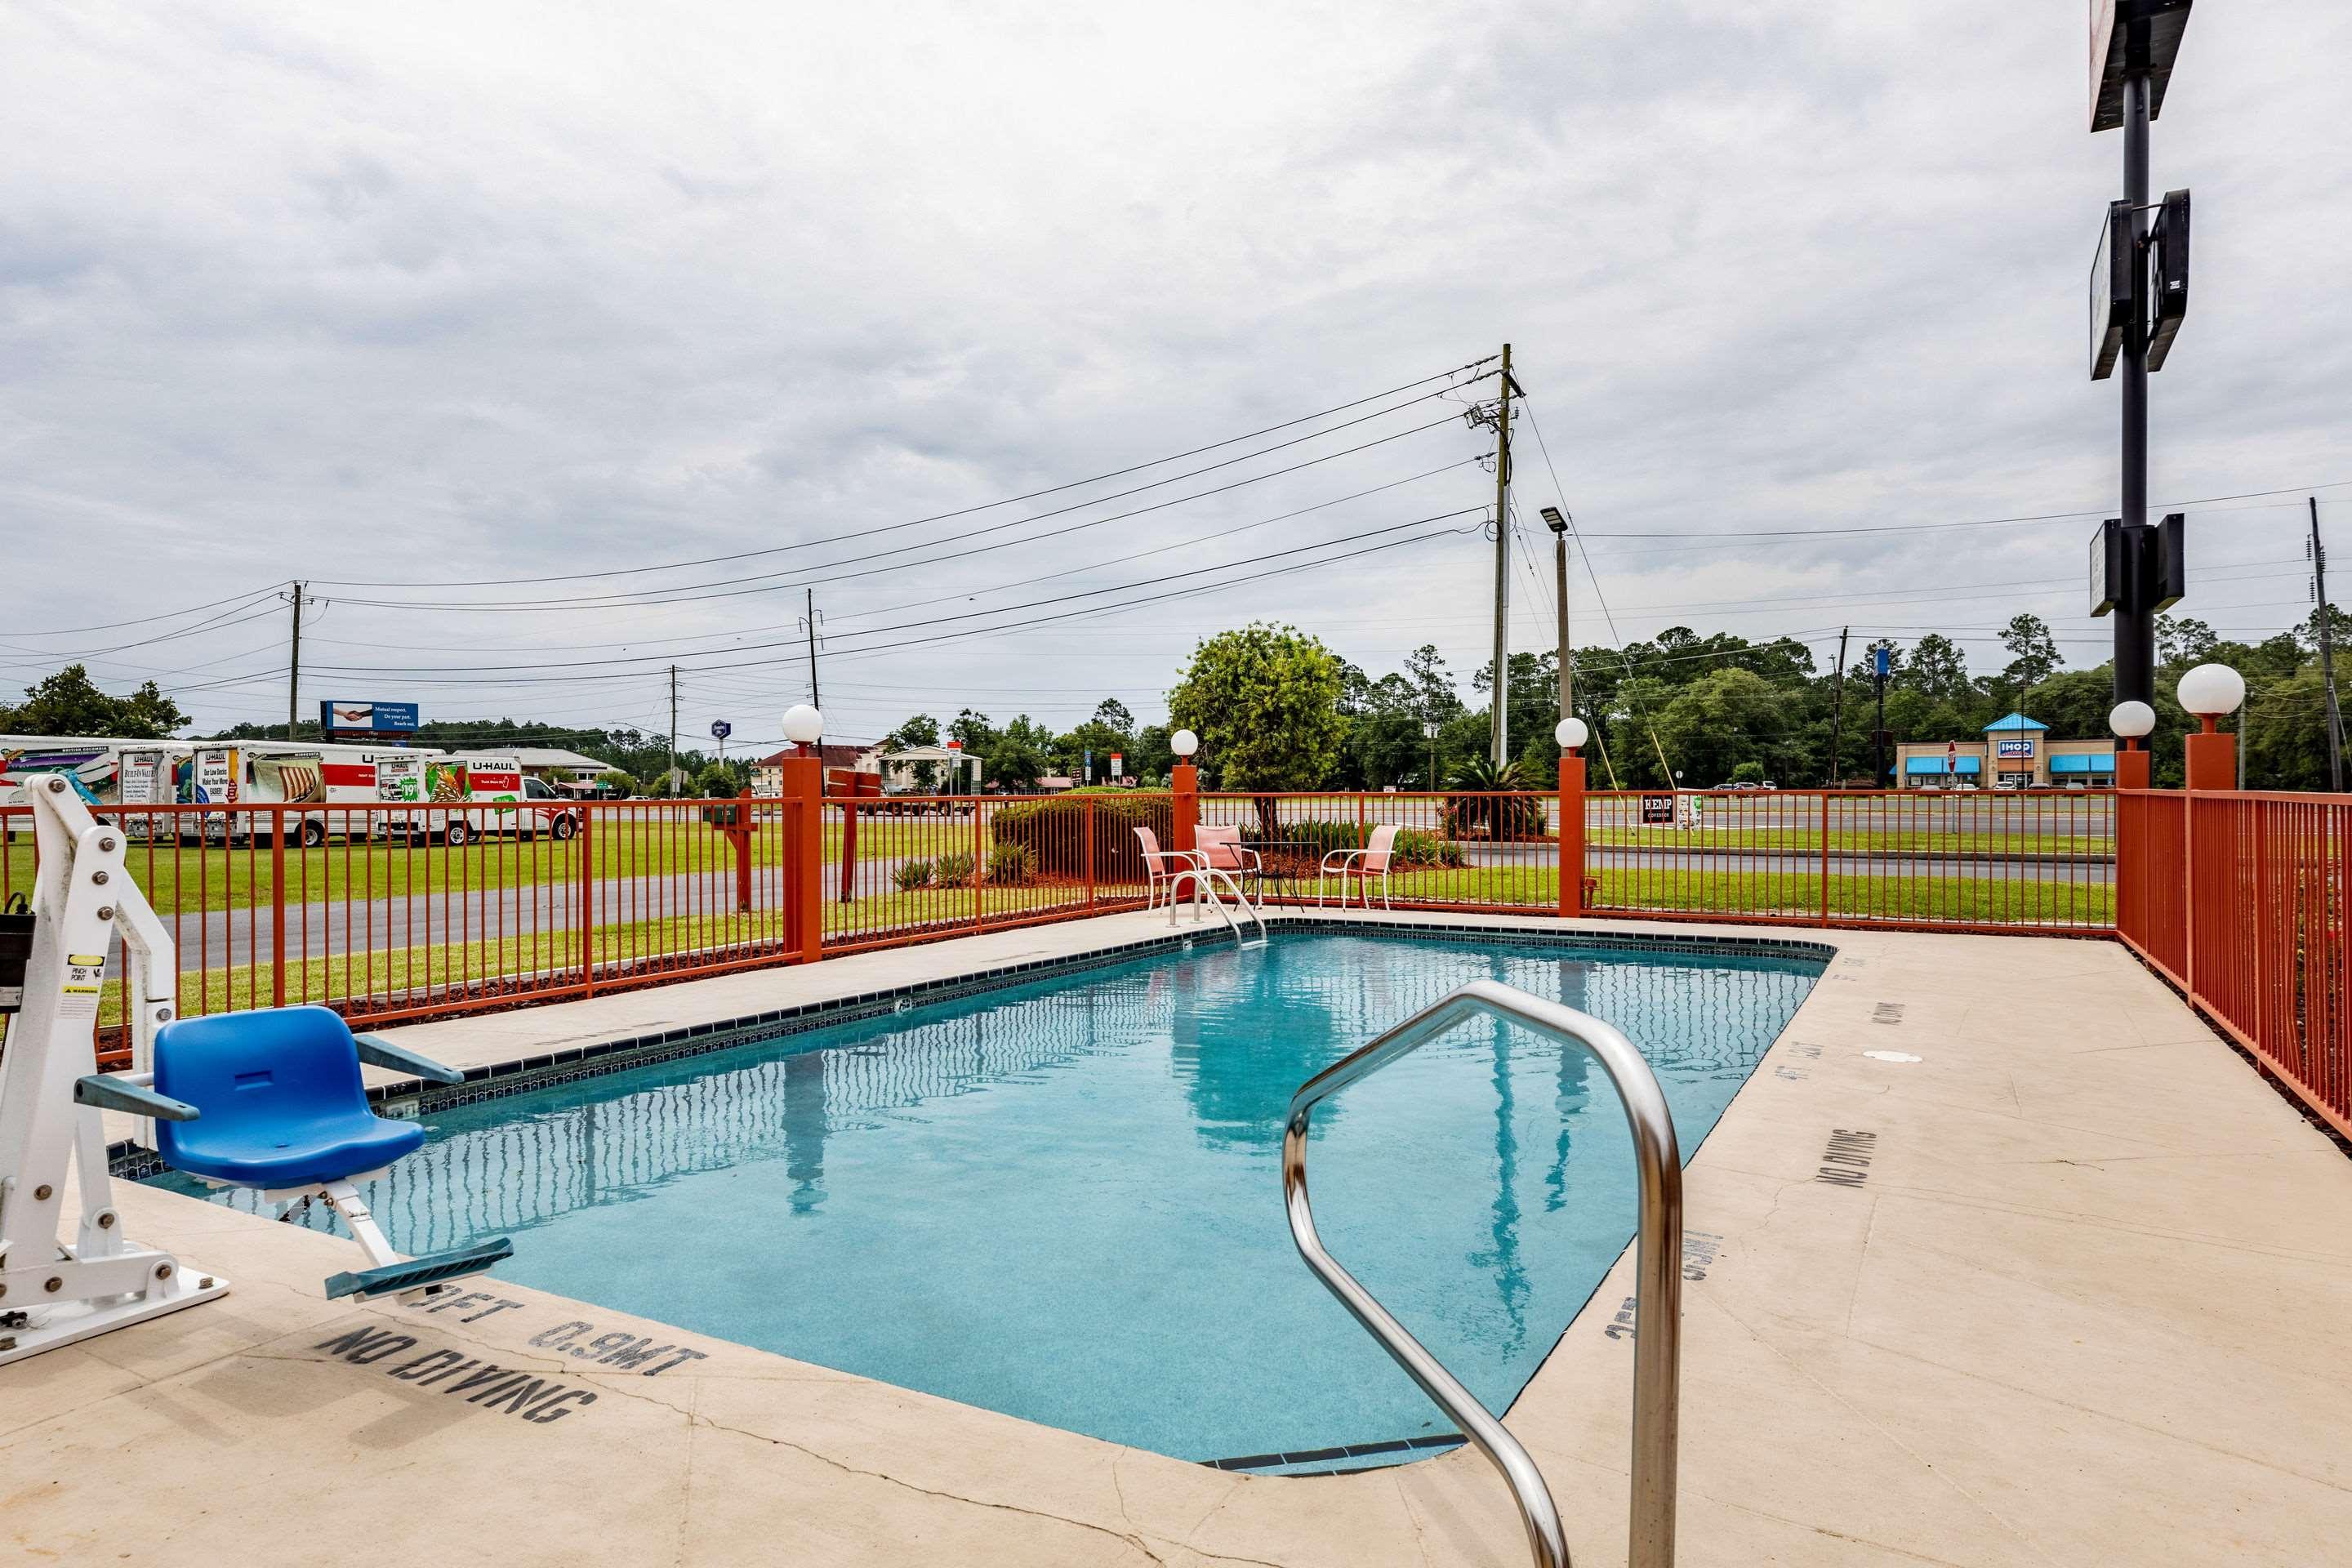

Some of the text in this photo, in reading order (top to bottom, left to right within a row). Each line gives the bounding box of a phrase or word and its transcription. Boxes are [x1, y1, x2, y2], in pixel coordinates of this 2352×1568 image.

[2002, 743, 2030, 751] IHOP
[1645, 799, 1672, 810] KEMP
[1815, 1129, 1877, 1189] NO DIVING
[314, 1325, 598, 1424] NO DIVING
